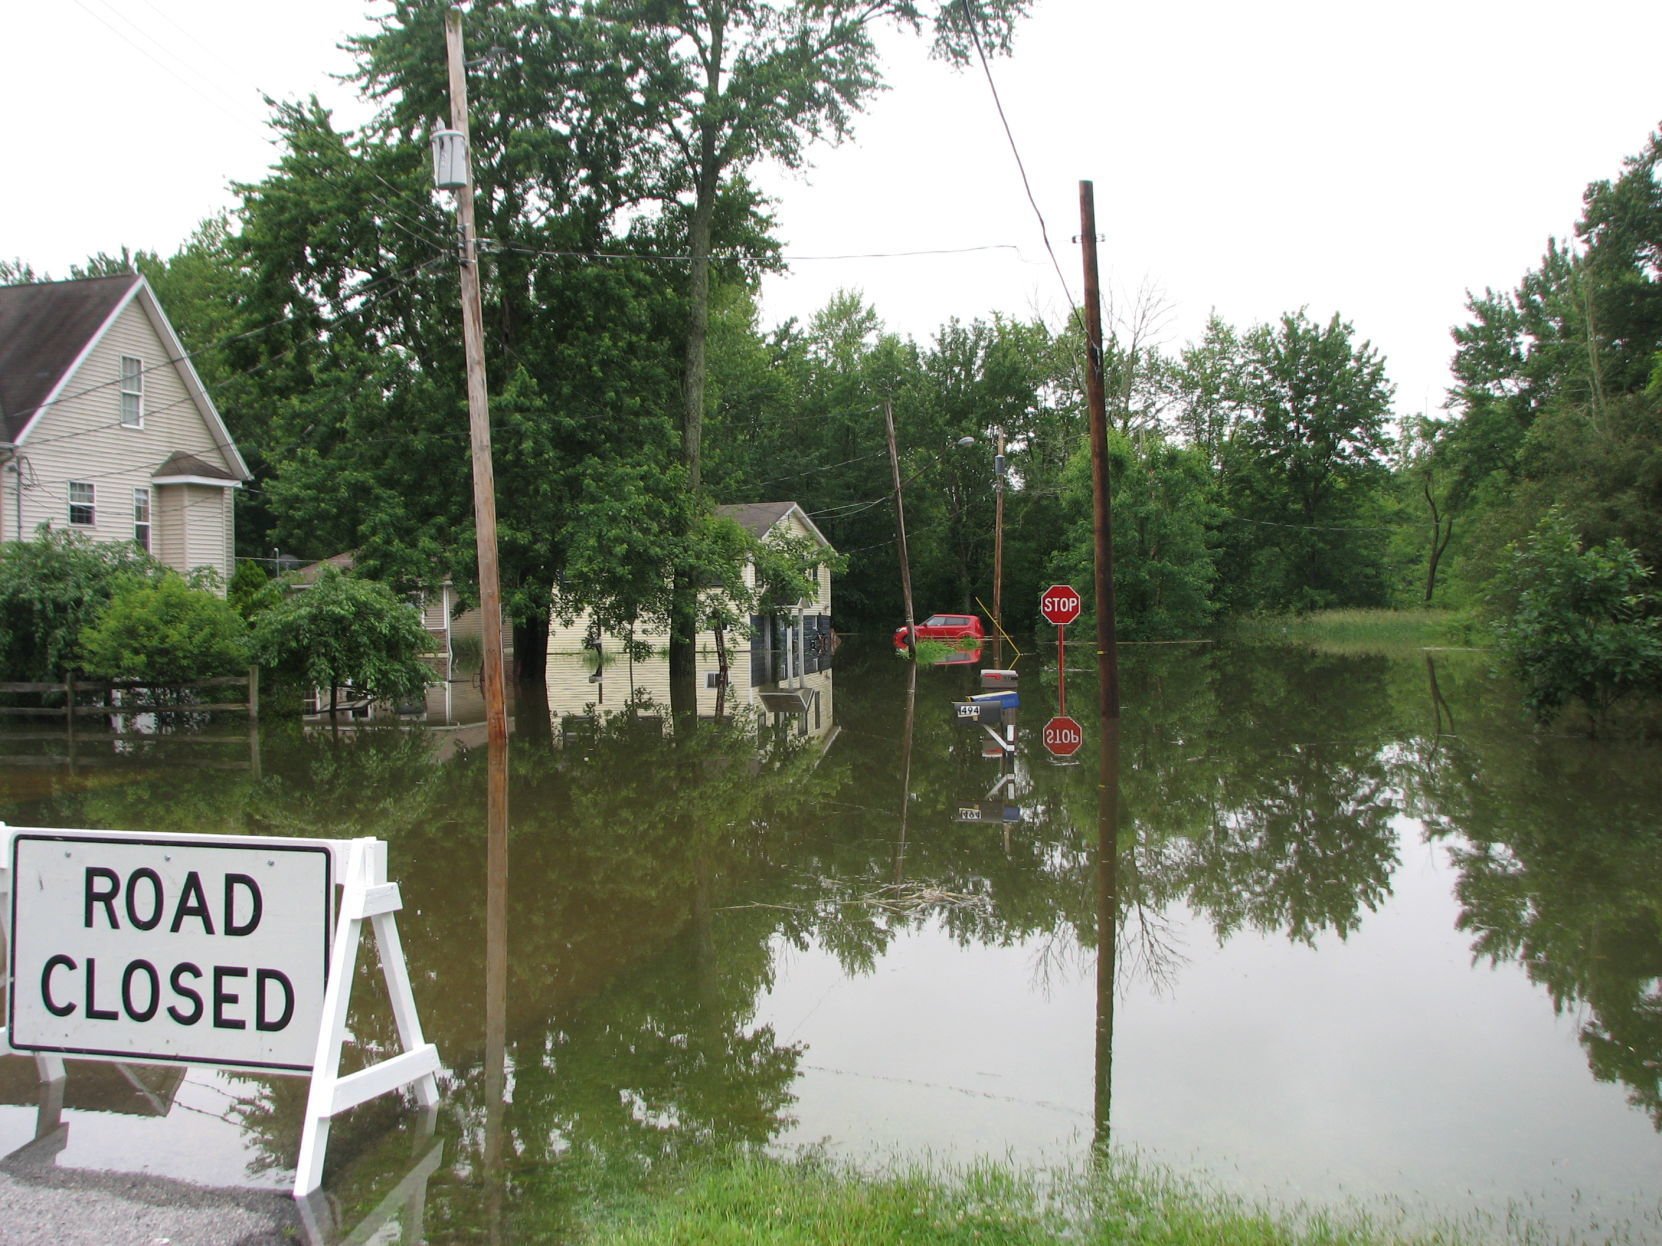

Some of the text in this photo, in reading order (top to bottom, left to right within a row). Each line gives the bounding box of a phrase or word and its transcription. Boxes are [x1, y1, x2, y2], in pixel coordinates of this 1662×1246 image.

[1044, 597, 1078, 612] STOP
[84, 866, 263, 937] ROAD
[41, 953, 295, 1032] CLOSED
